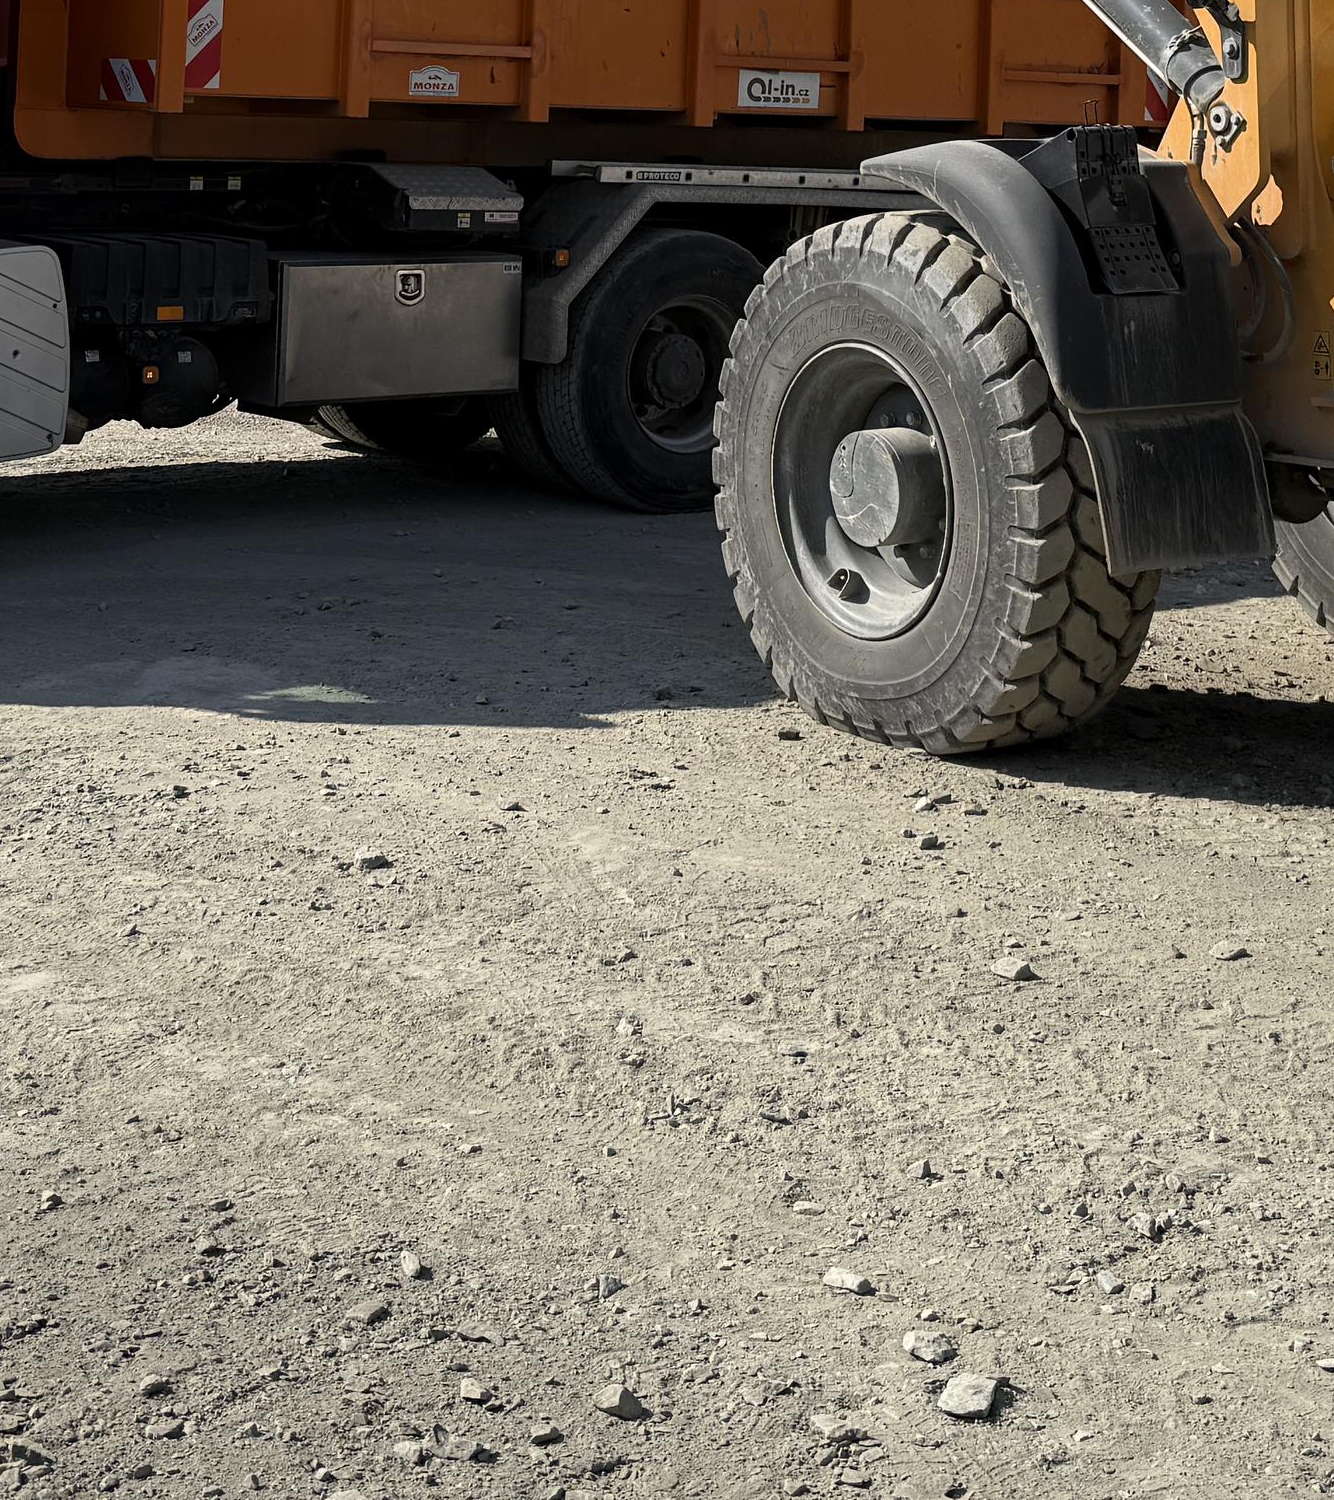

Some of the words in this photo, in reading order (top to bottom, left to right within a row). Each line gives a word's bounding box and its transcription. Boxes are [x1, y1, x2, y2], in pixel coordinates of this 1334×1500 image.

[191, 20, 216, 45] MONZA
[413, 82, 454, 90] MONZA
[643, 172, 680, 180] PROTECO
